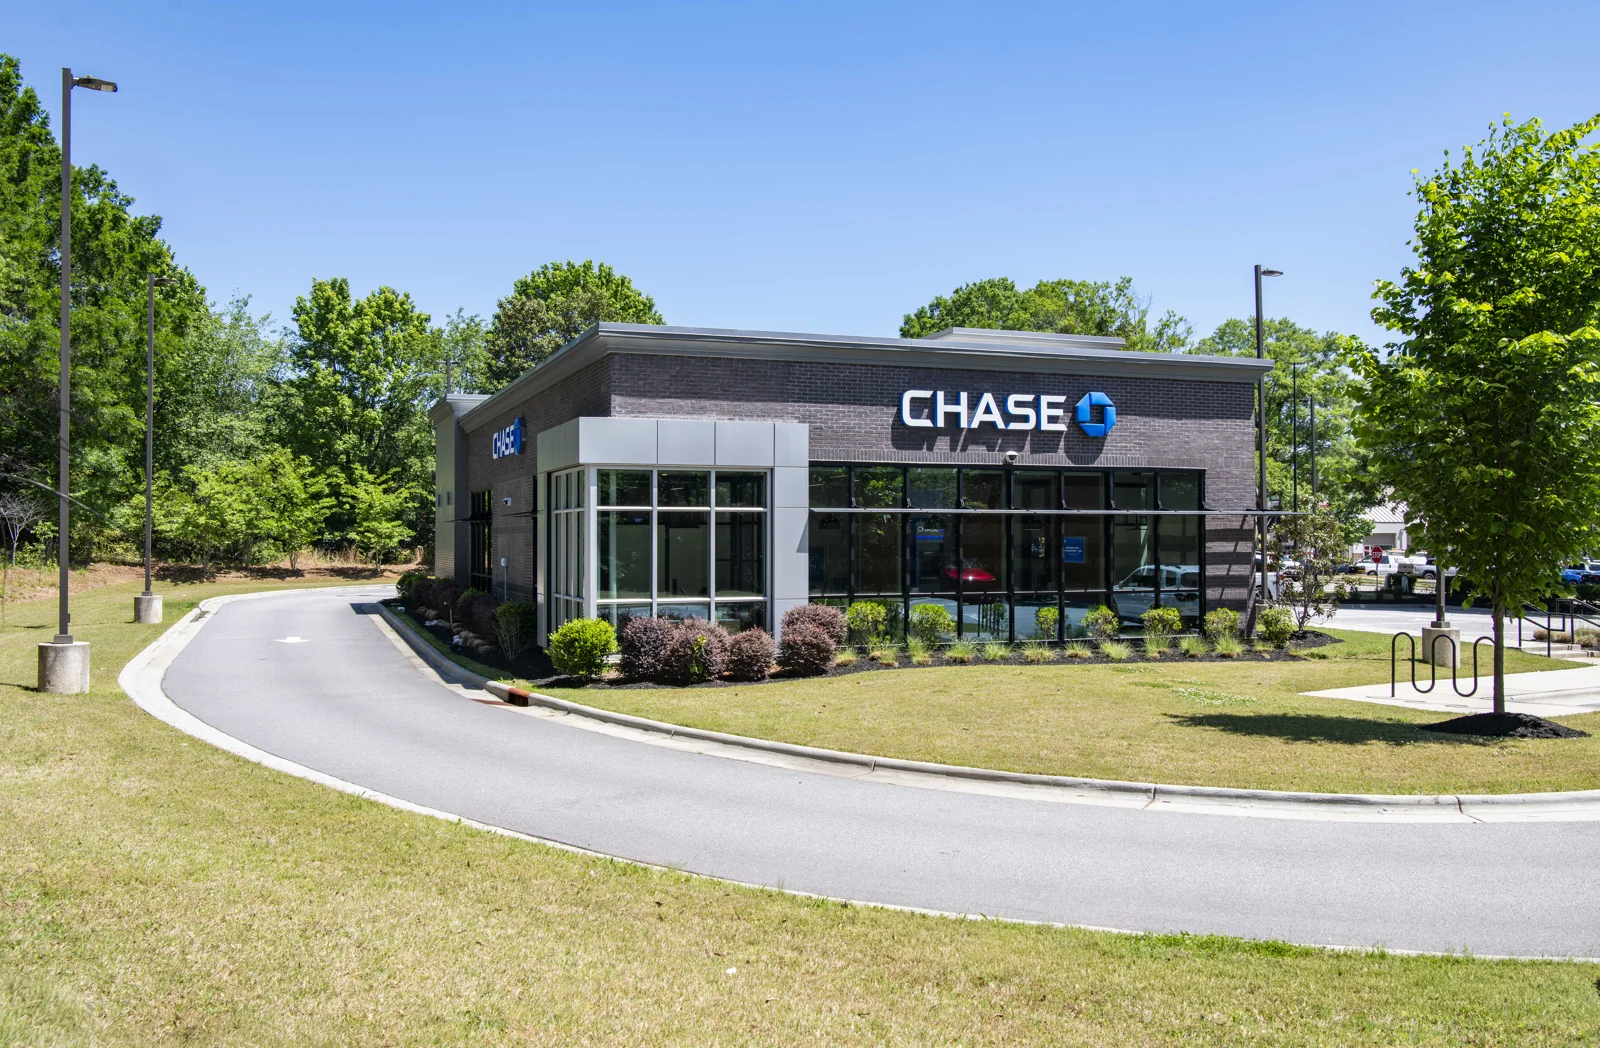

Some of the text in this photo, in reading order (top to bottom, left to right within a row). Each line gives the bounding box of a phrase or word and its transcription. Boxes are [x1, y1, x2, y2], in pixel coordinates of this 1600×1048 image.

[901, 389, 1068, 431] CHASE
[492, 424, 515, 460] CHASE
[1371, 551, 1382, 559] STOP
